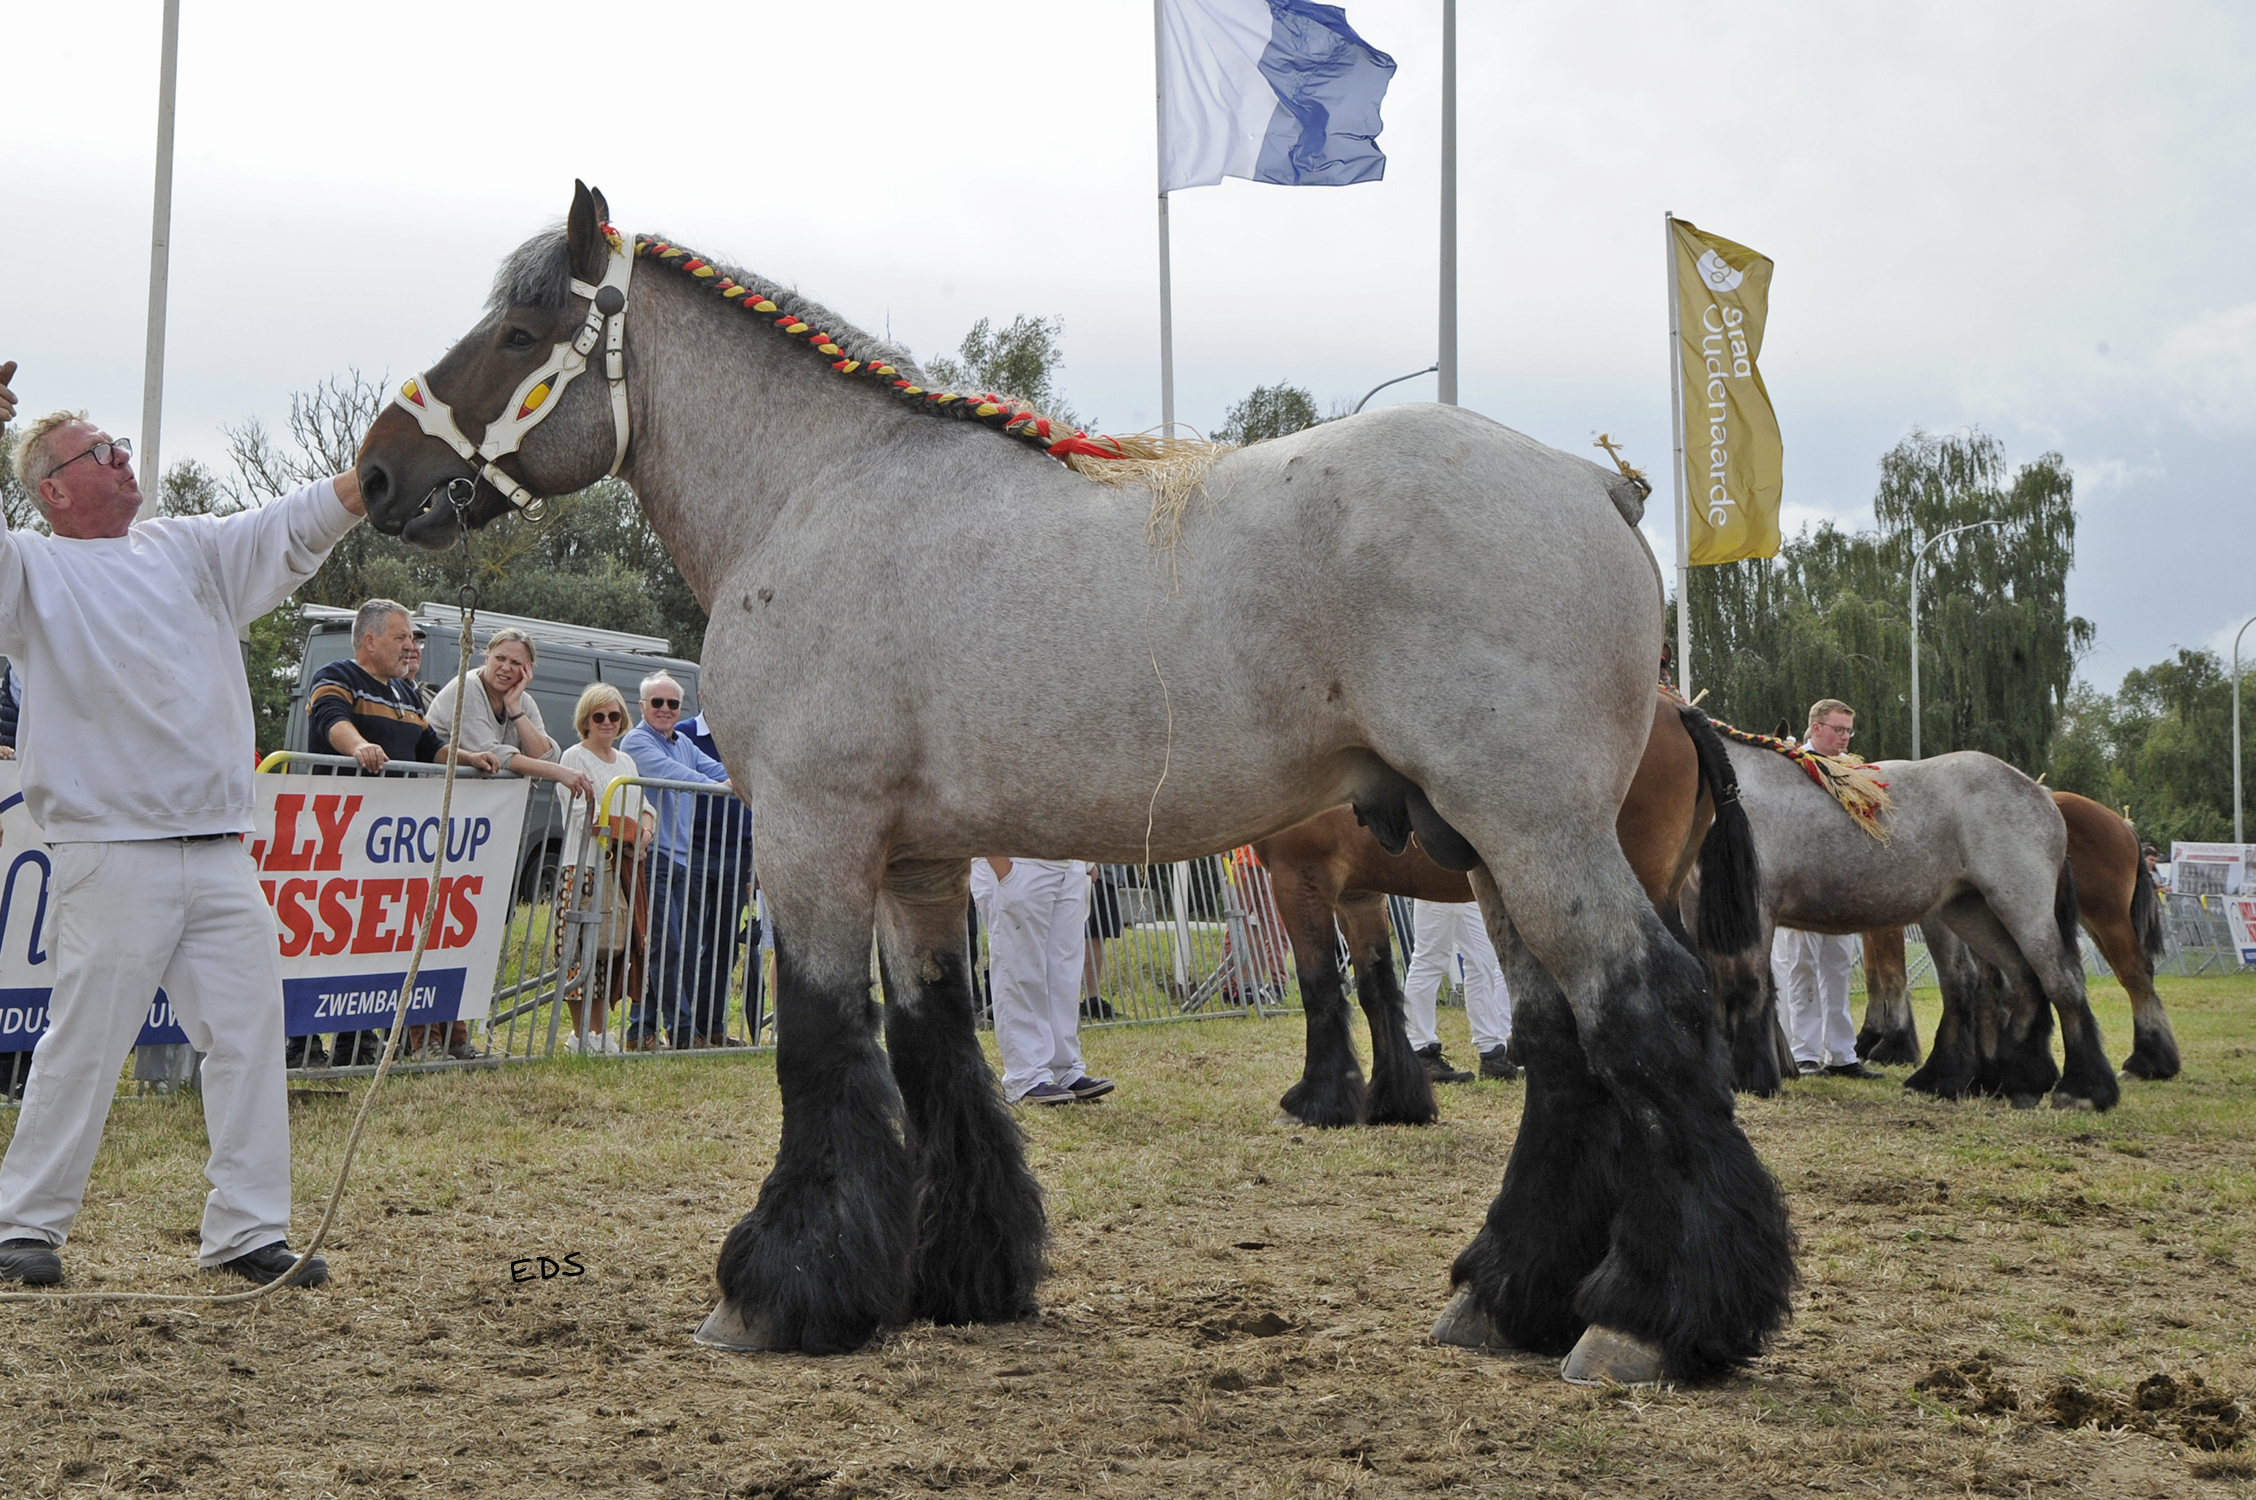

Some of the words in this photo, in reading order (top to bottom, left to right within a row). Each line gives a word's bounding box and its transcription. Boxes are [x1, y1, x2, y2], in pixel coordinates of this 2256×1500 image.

[1702, 303, 1736, 528] Oudenaarde
[239, 793, 364, 872] LY
[365, 815, 491, 864] GROUP
